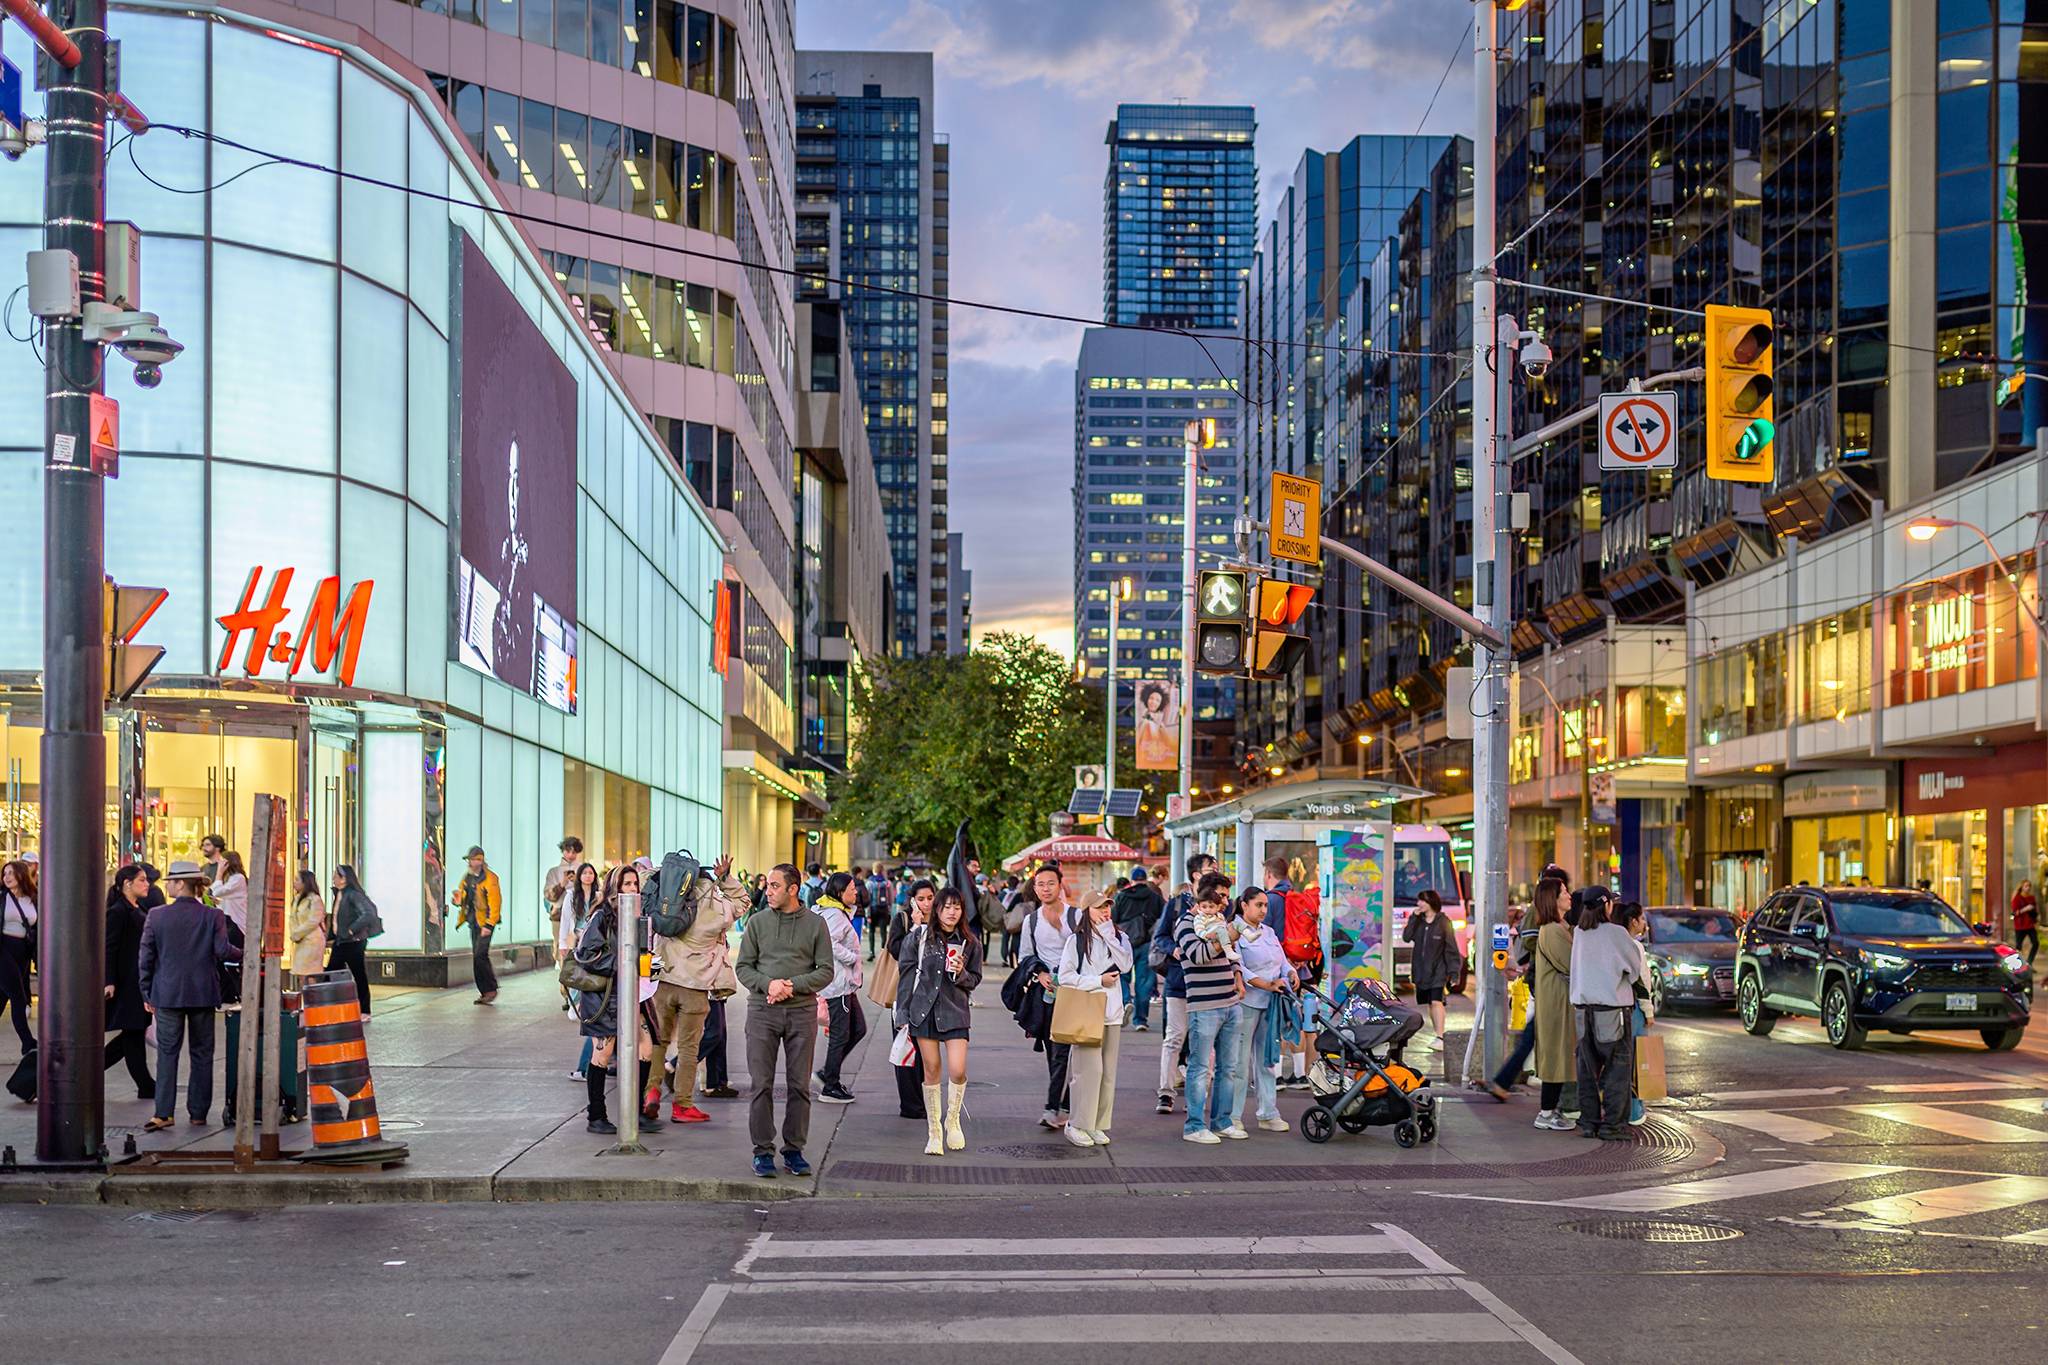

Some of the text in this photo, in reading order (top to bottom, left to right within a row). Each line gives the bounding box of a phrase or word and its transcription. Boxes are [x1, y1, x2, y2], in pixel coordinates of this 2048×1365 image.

[1281, 480, 1312, 498] PRIORITY
[1277, 539, 1311, 557] CROSSING
[215, 565, 375, 687] H&M
[1926, 593, 1971, 649] MUJI
[1919, 771, 1944, 800] MUJI
[1306, 803, 1356, 815] Yonge St
